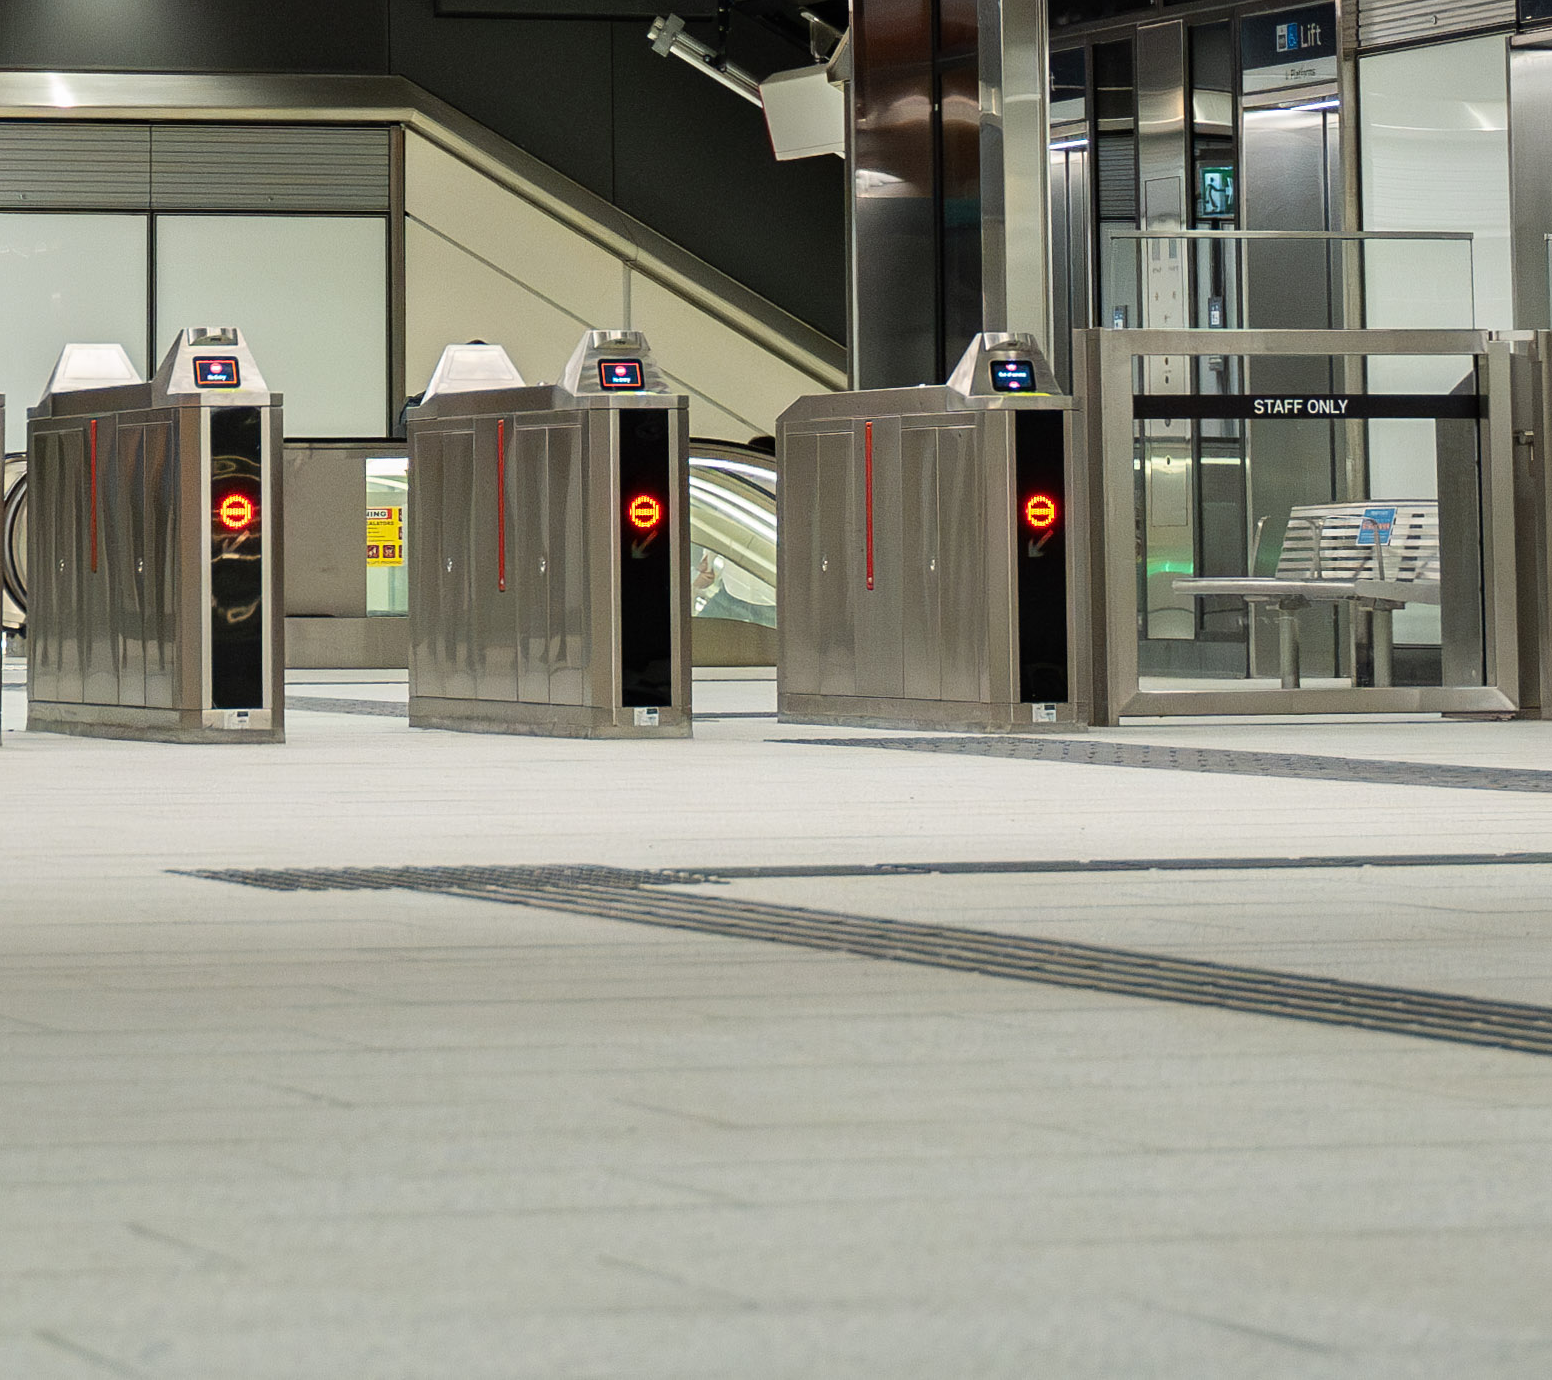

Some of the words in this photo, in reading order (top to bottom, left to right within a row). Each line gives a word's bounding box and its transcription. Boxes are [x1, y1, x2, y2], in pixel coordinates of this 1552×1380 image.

[1300, 23, 1322, 48] Lift
[1253, 399, 1304, 415] STAFF
[1307, 399, 1349, 415] ONLY
